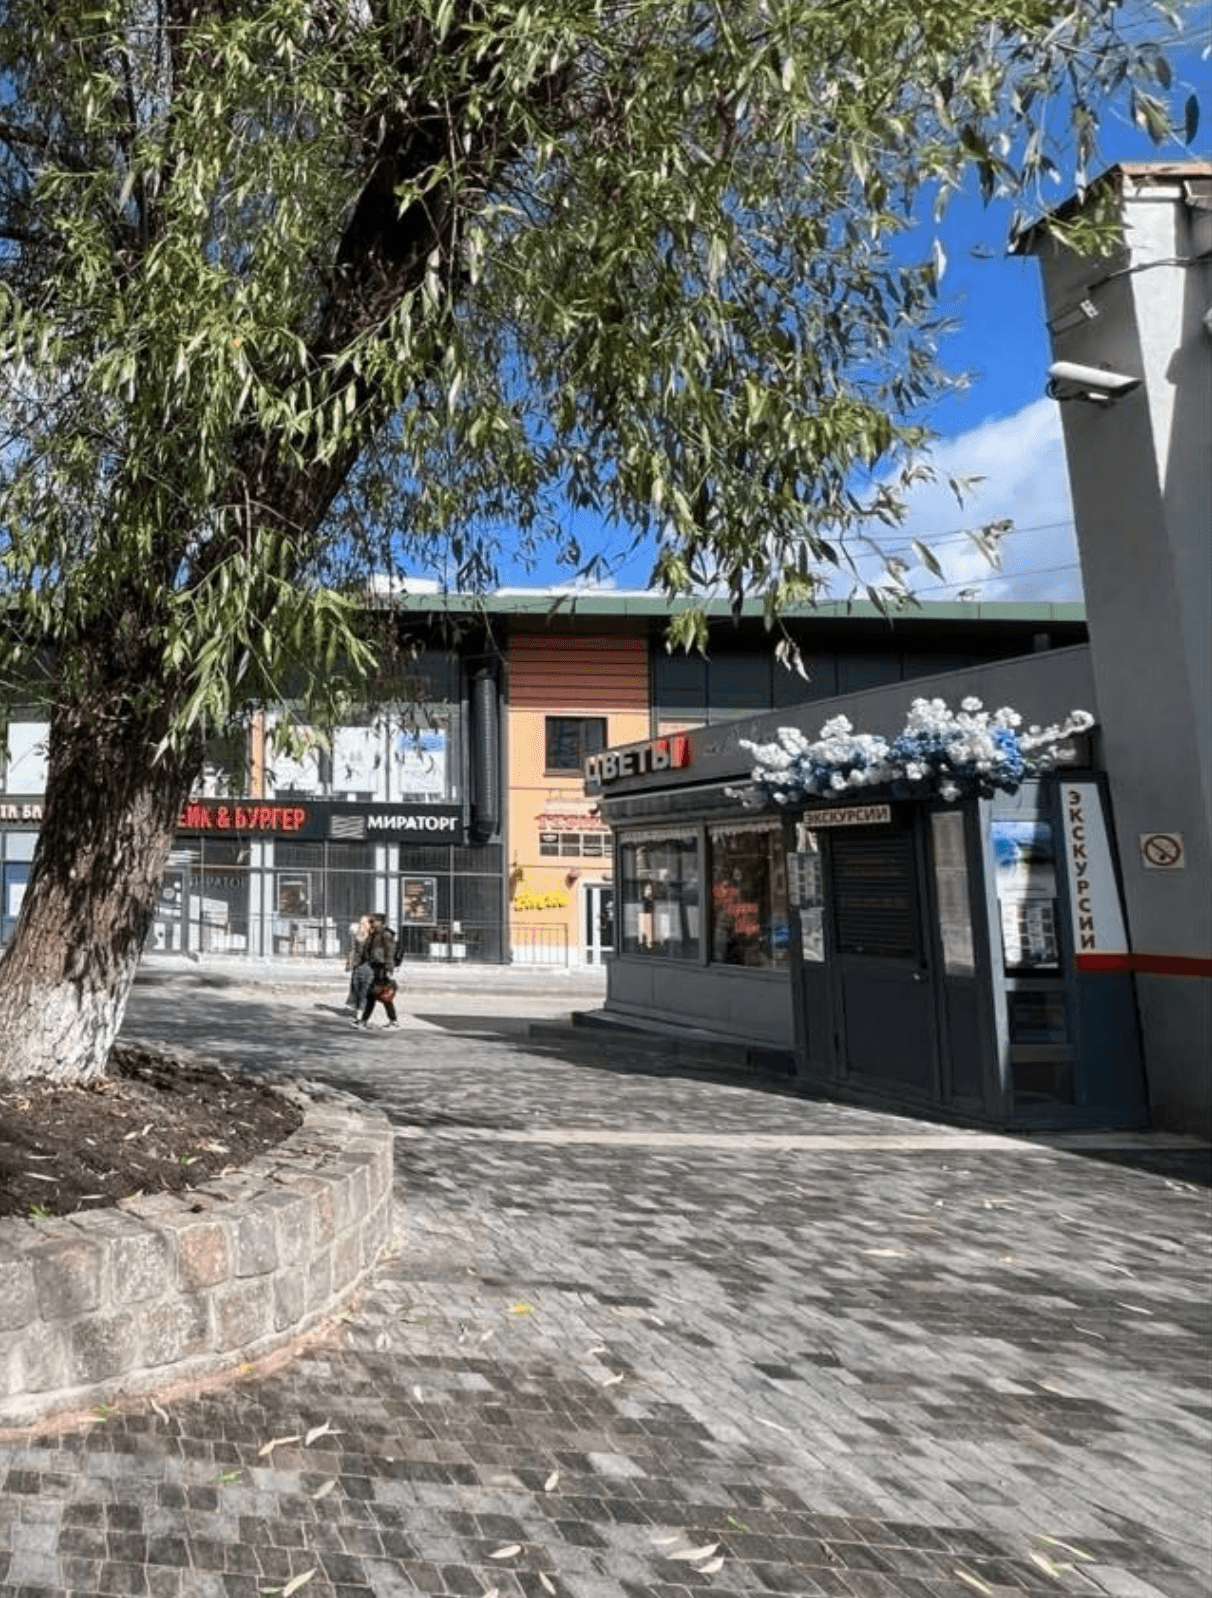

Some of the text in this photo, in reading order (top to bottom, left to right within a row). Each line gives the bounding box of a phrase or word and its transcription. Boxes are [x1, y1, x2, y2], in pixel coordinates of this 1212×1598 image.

[585, 735, 688, 787] ЦВЕТЫ
[23, 804, 44, 819] БА
[176, 800, 306, 831] ЕЙК & БУРГЕР
[367, 814, 459, 832] МИРАТОРГ
[805, 806, 890, 826] ЭКСКУРСИИ
[1067, 790, 1096, 949] ЭКСКУРСИИ
